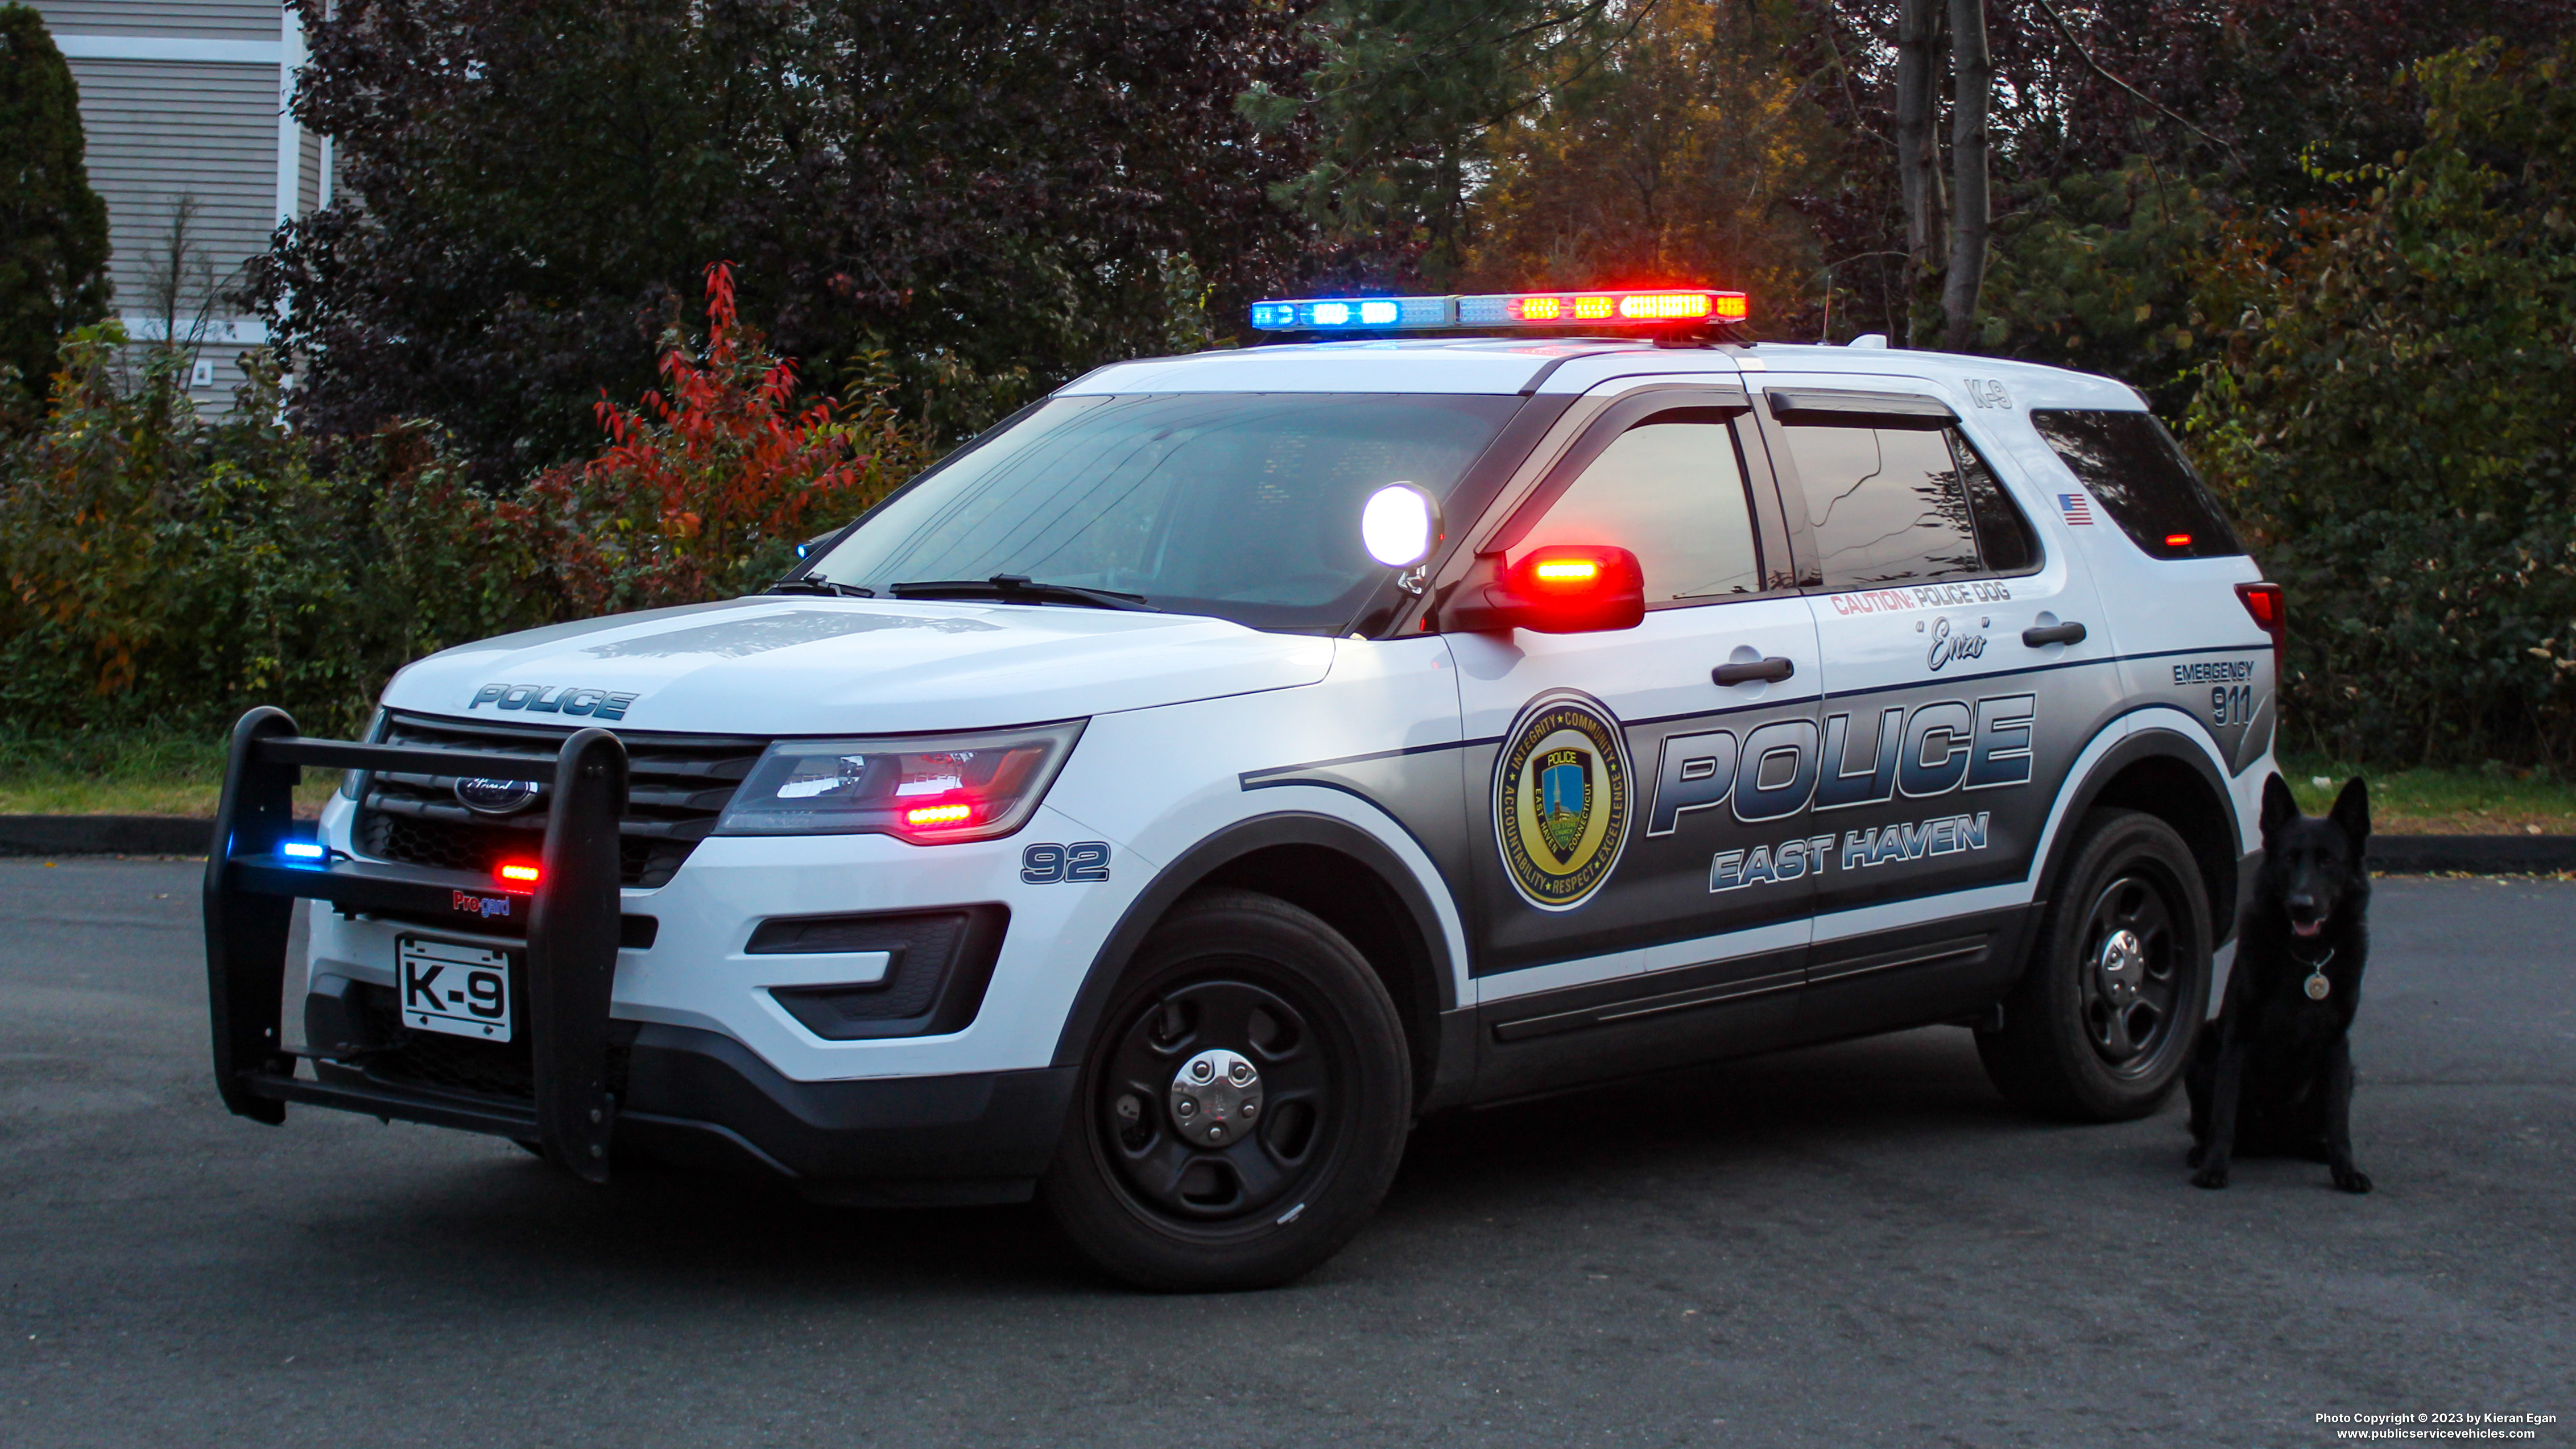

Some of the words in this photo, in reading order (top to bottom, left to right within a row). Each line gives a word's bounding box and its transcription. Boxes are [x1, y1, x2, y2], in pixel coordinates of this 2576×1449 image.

[1963, 379, 2012, 409] K-9
[1830, 589, 1916, 615] CAUTION:
[1912, 583, 1973, 607] POLICE
[1971, 581, 2011, 602] DOG
[2173, 661, 2254, 685] EMERGENCY
[468, 683, 643, 722] POLICE
[2211, 683, 2251, 727] 911
[1511, 713, 1557, 771] INTEGRITY
[1548, 751, 1577, 766] POLICE
[1565, 711, 1615, 763] COMMUNITY
[1646, 692, 2036, 837] POLICE
[1504, 785, 1545, 891] ACCOUNTABILITY
[1541, 821, 1558, 853] HAVEN
[1569, 783, 1591, 851] CONNECTICUT
[1599, 771, 1622, 862] EXCELLENCE
[1020, 841, 1111, 885] 92
[1710, 834, 1836, 893] EAST
[1842, 812, 1990, 870] HAVEN
[1552, 865, 1595, 893] RESPECT
[453, 890, 510, 918] Pro-gard
[406, 961, 505, 1019] K-9
